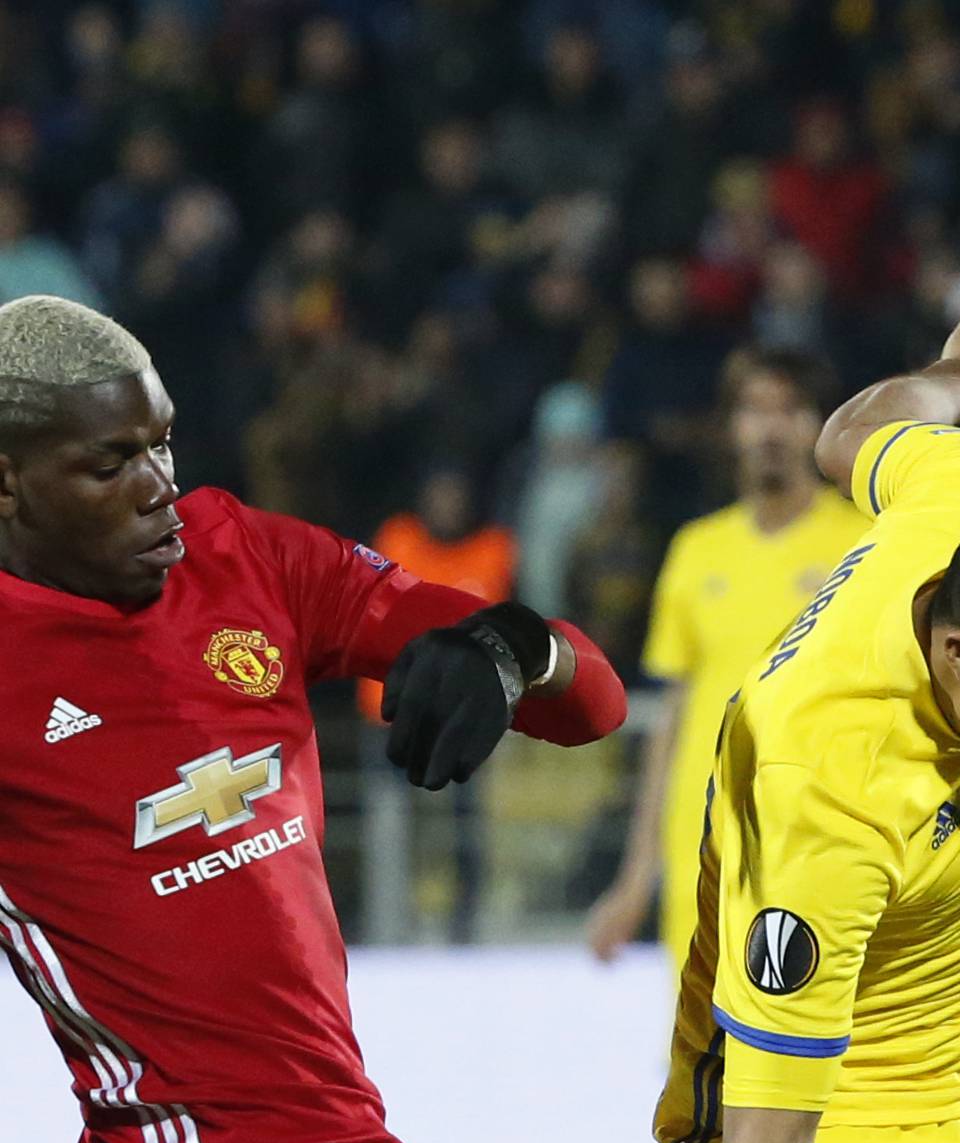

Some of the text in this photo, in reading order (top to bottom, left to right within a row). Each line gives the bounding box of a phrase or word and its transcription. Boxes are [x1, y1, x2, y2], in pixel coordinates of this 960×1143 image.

[243, 673, 279, 694] UNITED
[44, 714, 102, 743] adidas
[150, 816, 307, 896] CHEVROLET
